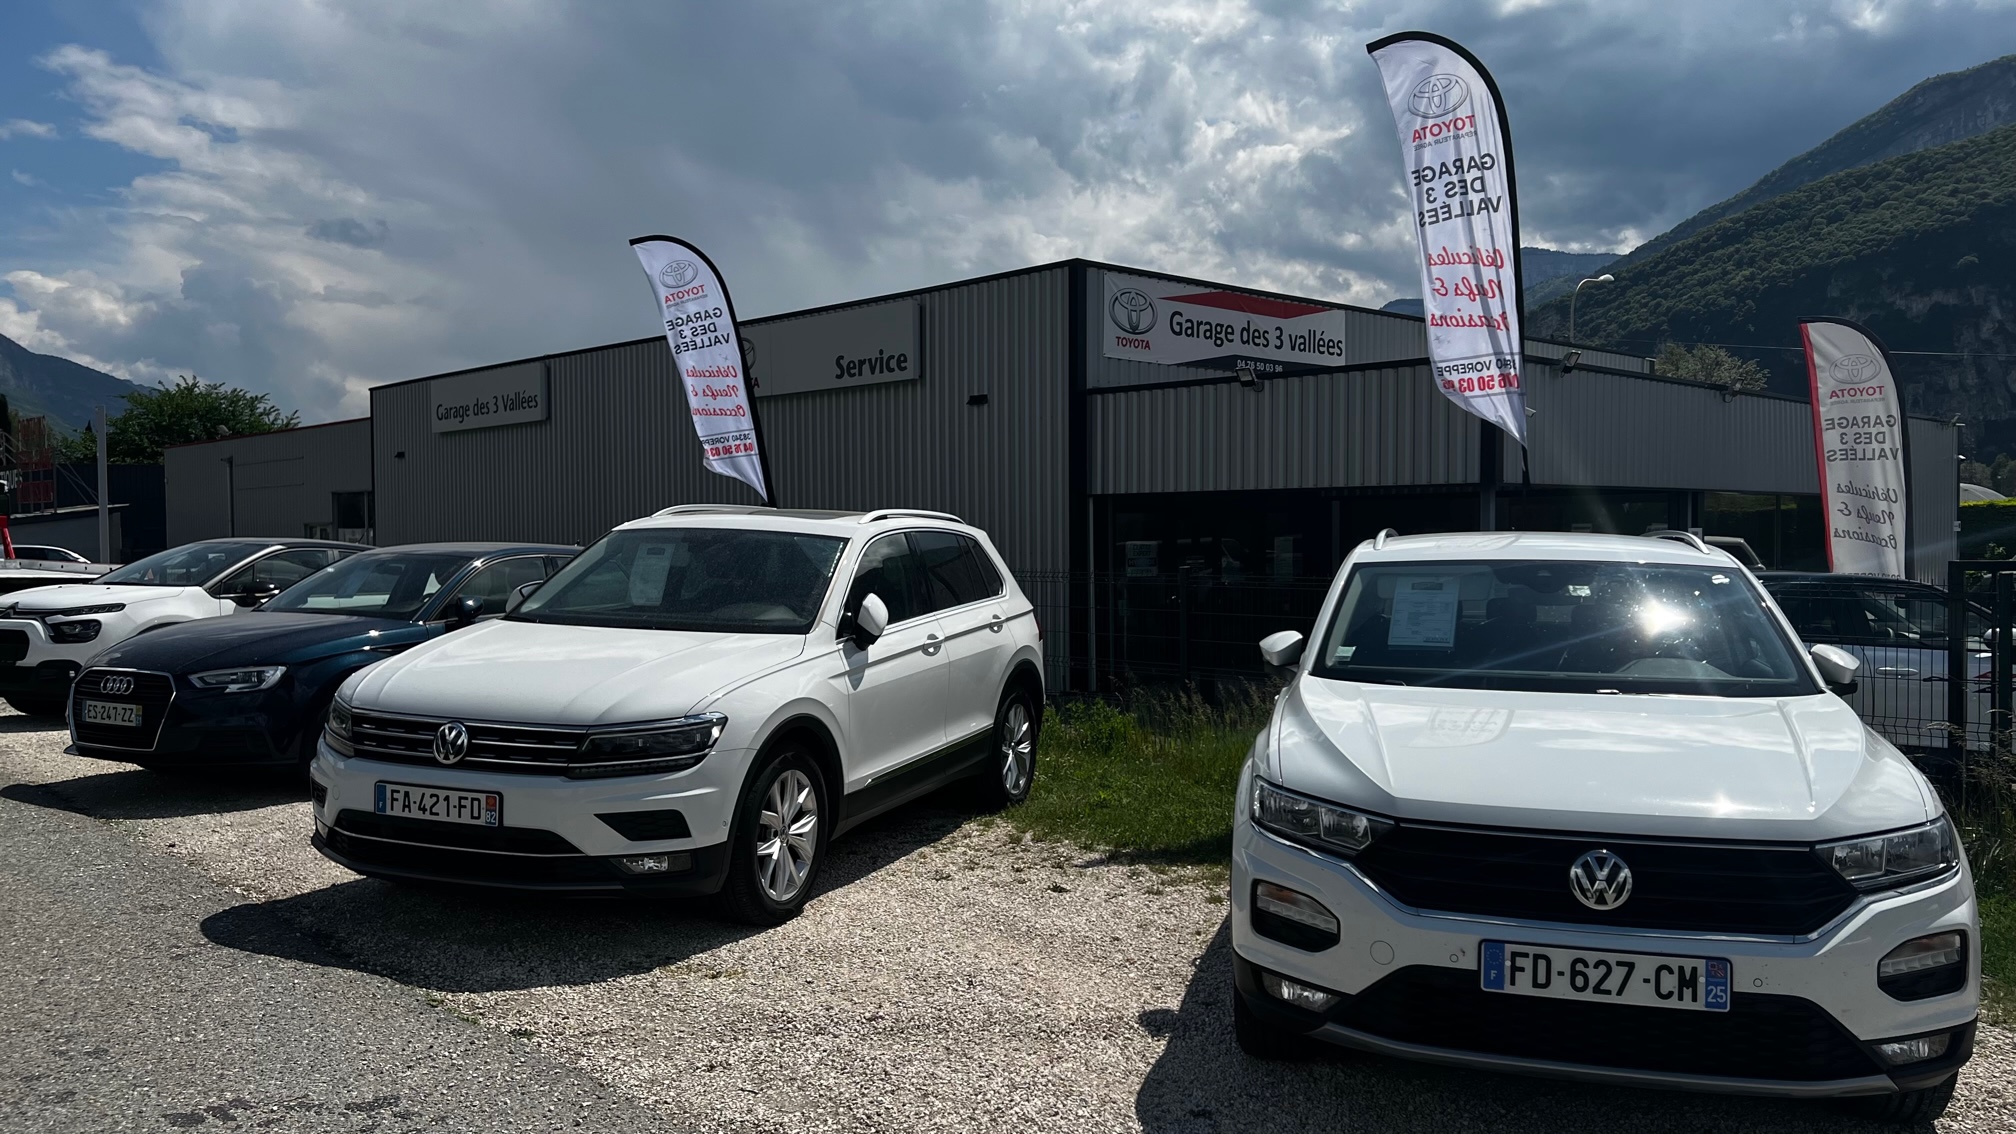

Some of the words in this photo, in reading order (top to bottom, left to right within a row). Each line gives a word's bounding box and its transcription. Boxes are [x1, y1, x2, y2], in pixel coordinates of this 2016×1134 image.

[1115, 335, 1151, 351] TOYOTA
[1169, 310, 1235, 348] Garage
[1240, 320, 1270, 348] des
[1274, 326, 1284, 350] 3
[1288, 329, 1343, 357] vallées
[835, 348, 908, 380] Service
[1237, 359, 1246, 368] 04
[1256, 361, 1265, 371] 50
[1265, 363, 1274, 372] 03
[1274, 364, 1283, 373] 96
[436, 403, 471, 424] Garage
[473, 397, 490, 416] des
[492, 396, 499, 414] 3
[501, 390, 539, 412] Vallées
[87, 704, 134, 723] ES-247-ZZ
[390, 789, 482, 820] FA-421-FD
[485, 811, 496, 823] 82
[1491, 970, 1497, 981] F
[1509, 950, 1699, 1003] FD-627-CM
[1707, 985, 1726, 1003] 25
